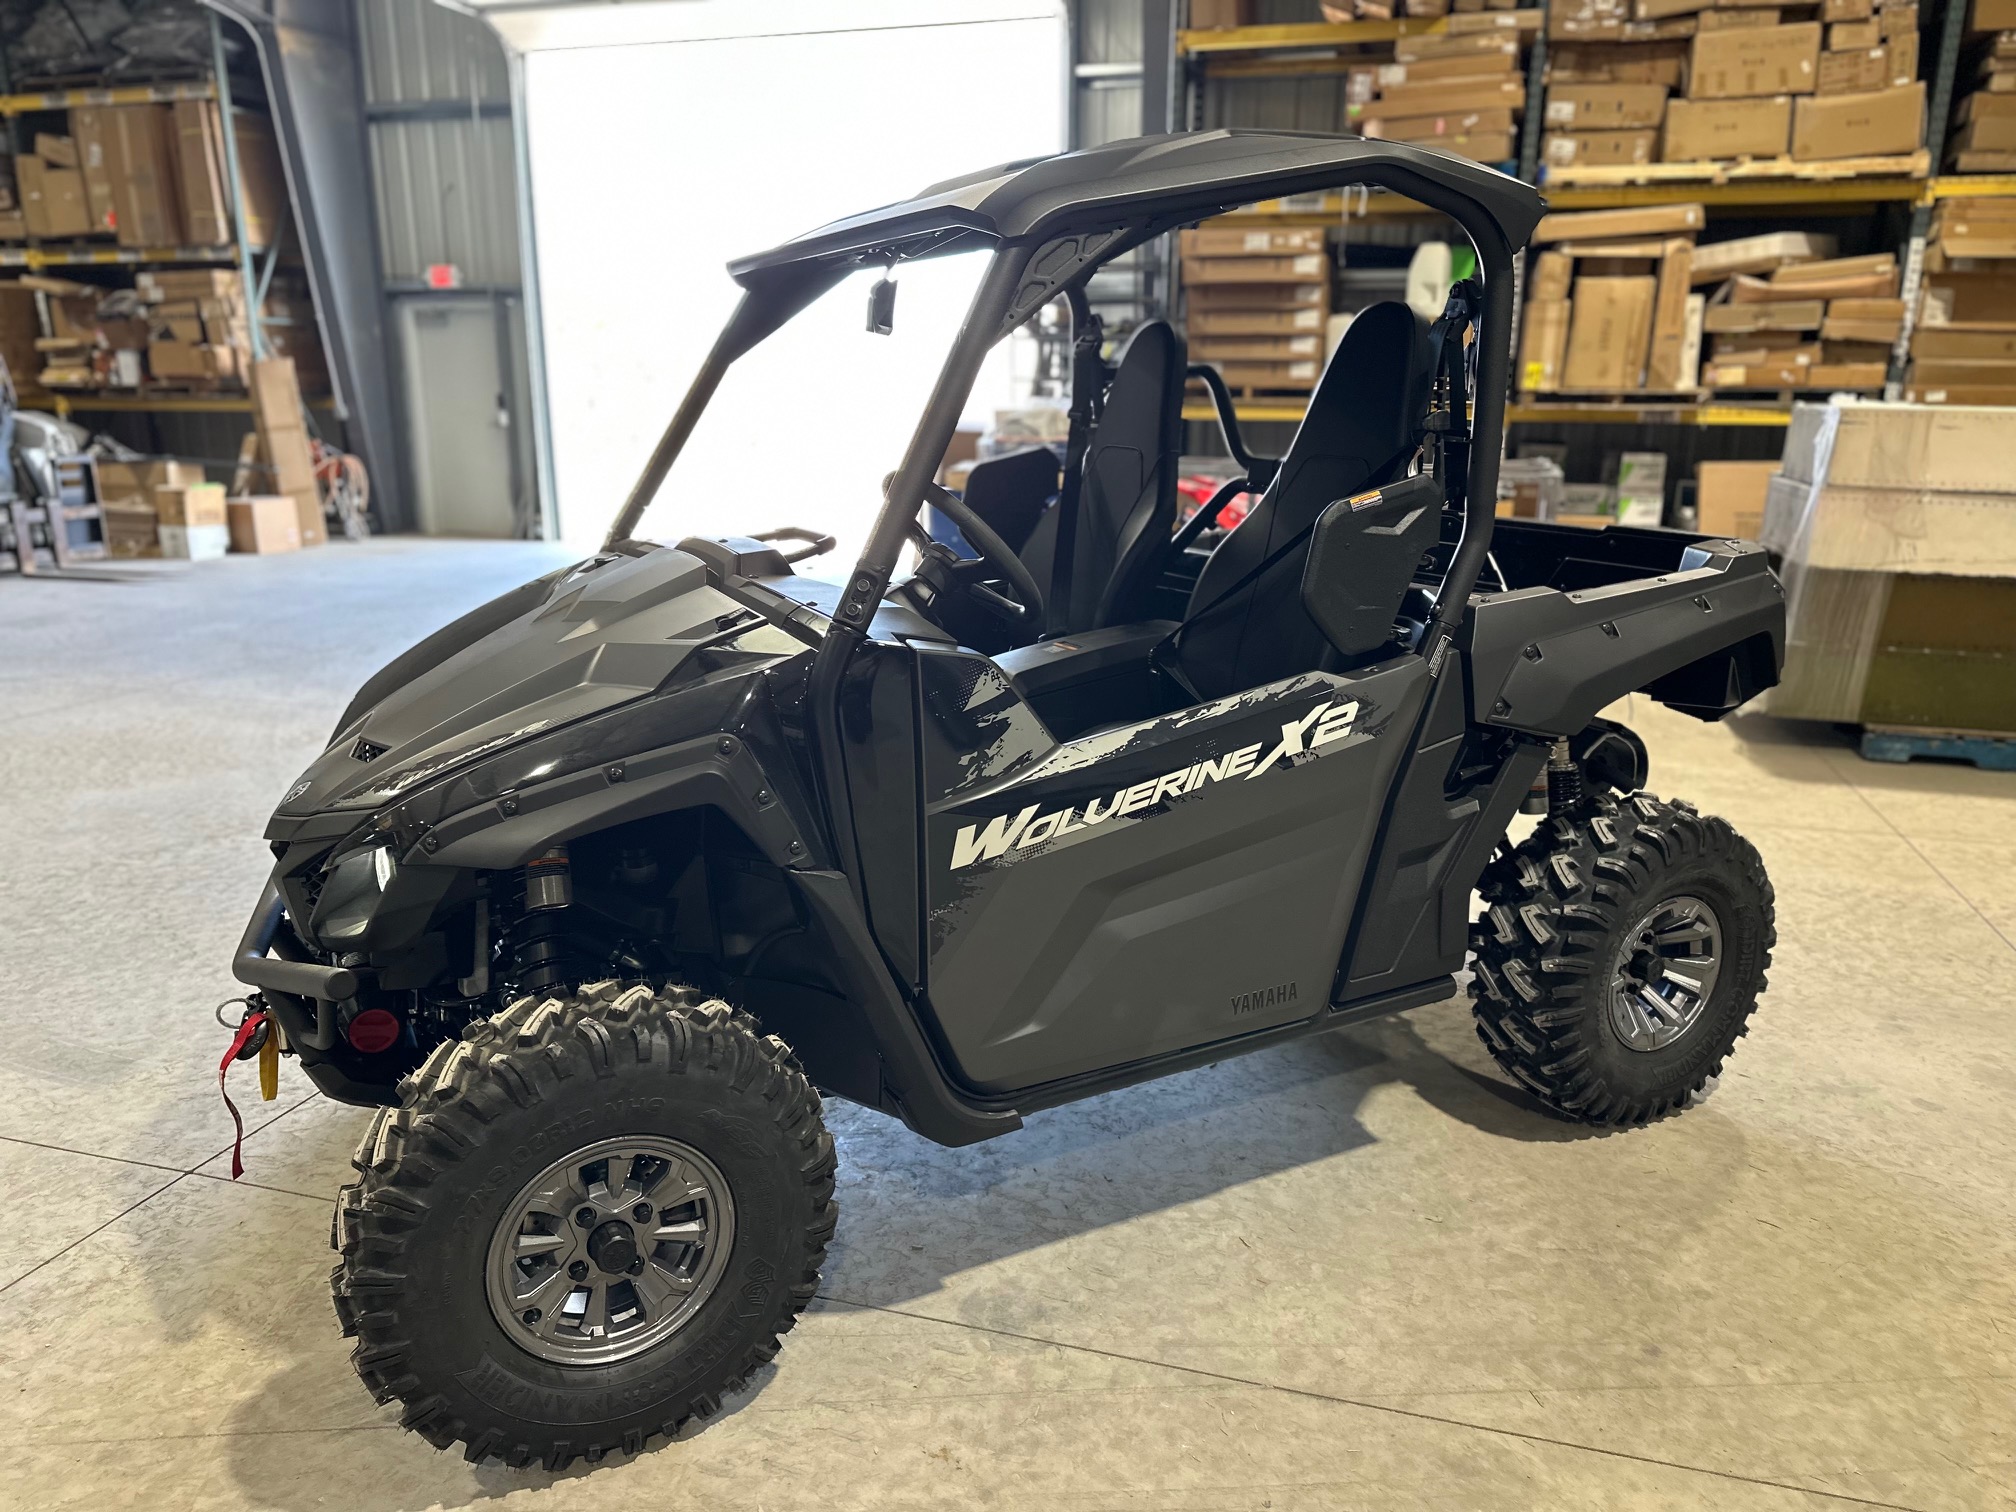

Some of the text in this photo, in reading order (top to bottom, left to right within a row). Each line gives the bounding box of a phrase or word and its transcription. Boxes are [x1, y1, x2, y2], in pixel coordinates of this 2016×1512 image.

[950, 700, 1359, 870] WOLVERINE X2
[1230, 980, 1298, 1016] YAMAHA
